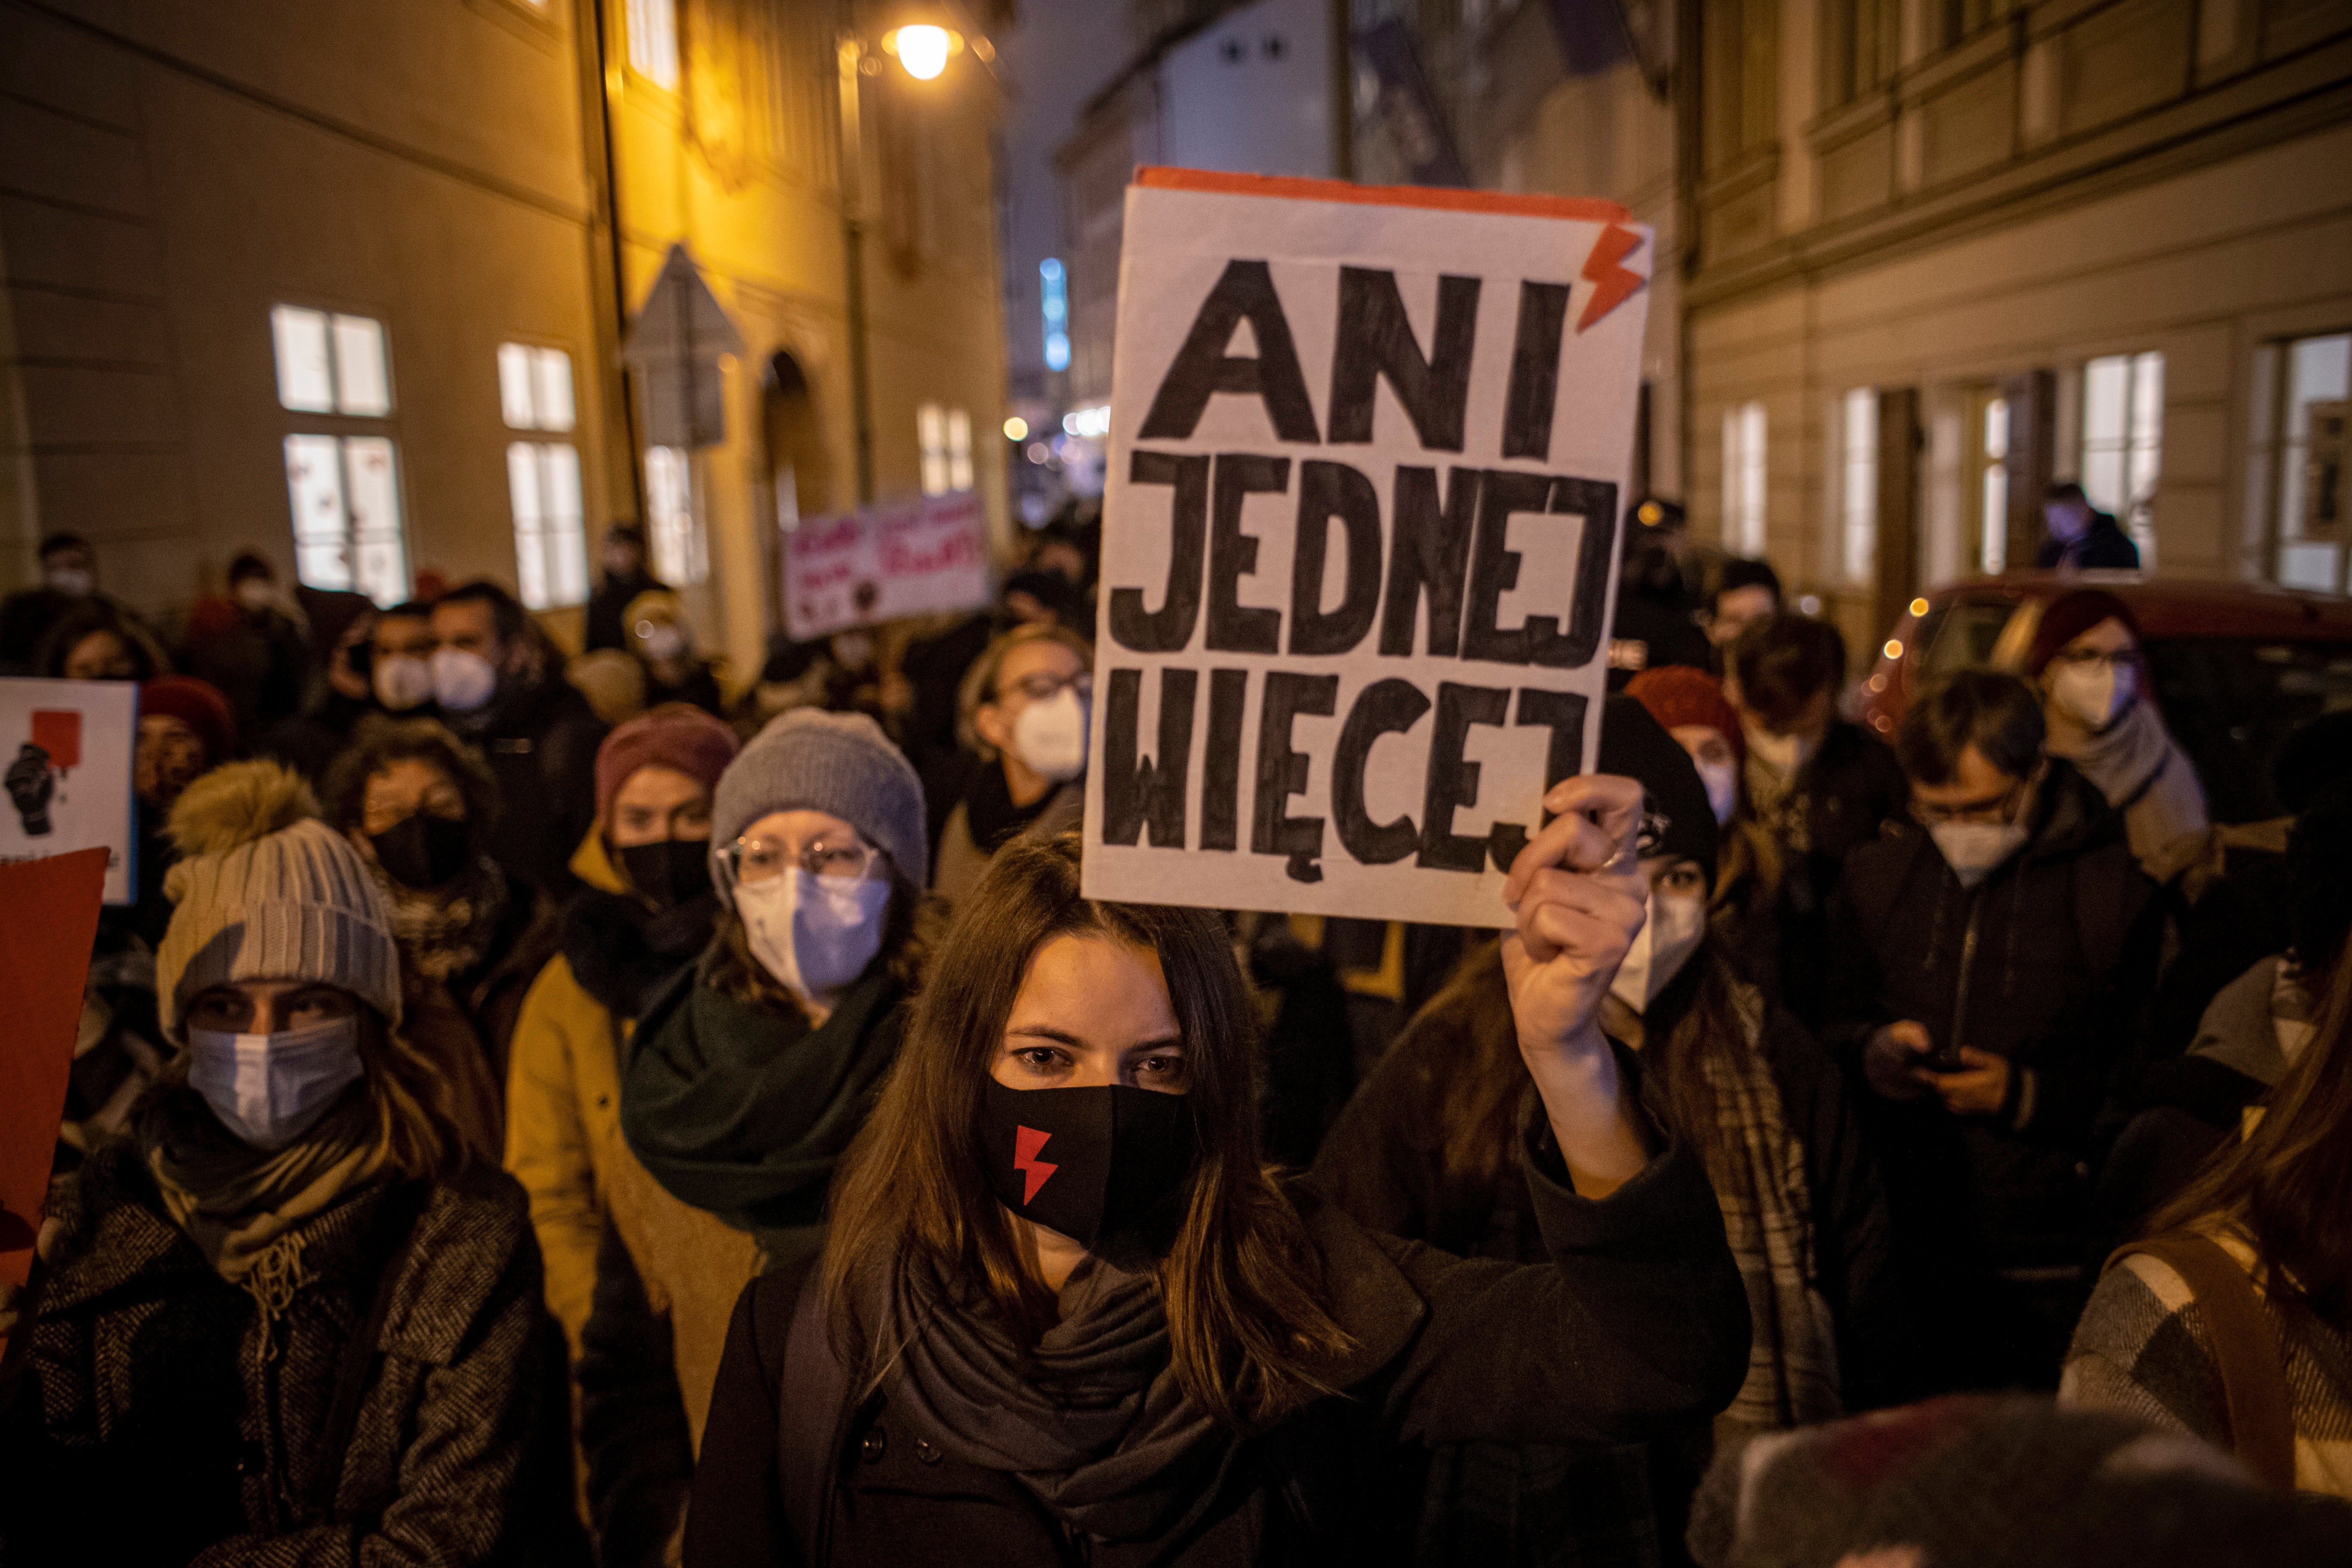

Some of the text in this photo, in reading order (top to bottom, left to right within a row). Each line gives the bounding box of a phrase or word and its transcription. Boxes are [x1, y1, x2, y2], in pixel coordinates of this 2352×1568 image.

[1136, 259, 1572, 464] ANI
[1109, 449, 1618, 669] JEDNEJ
[1103, 667, 1589, 884] WIĘCEJ
